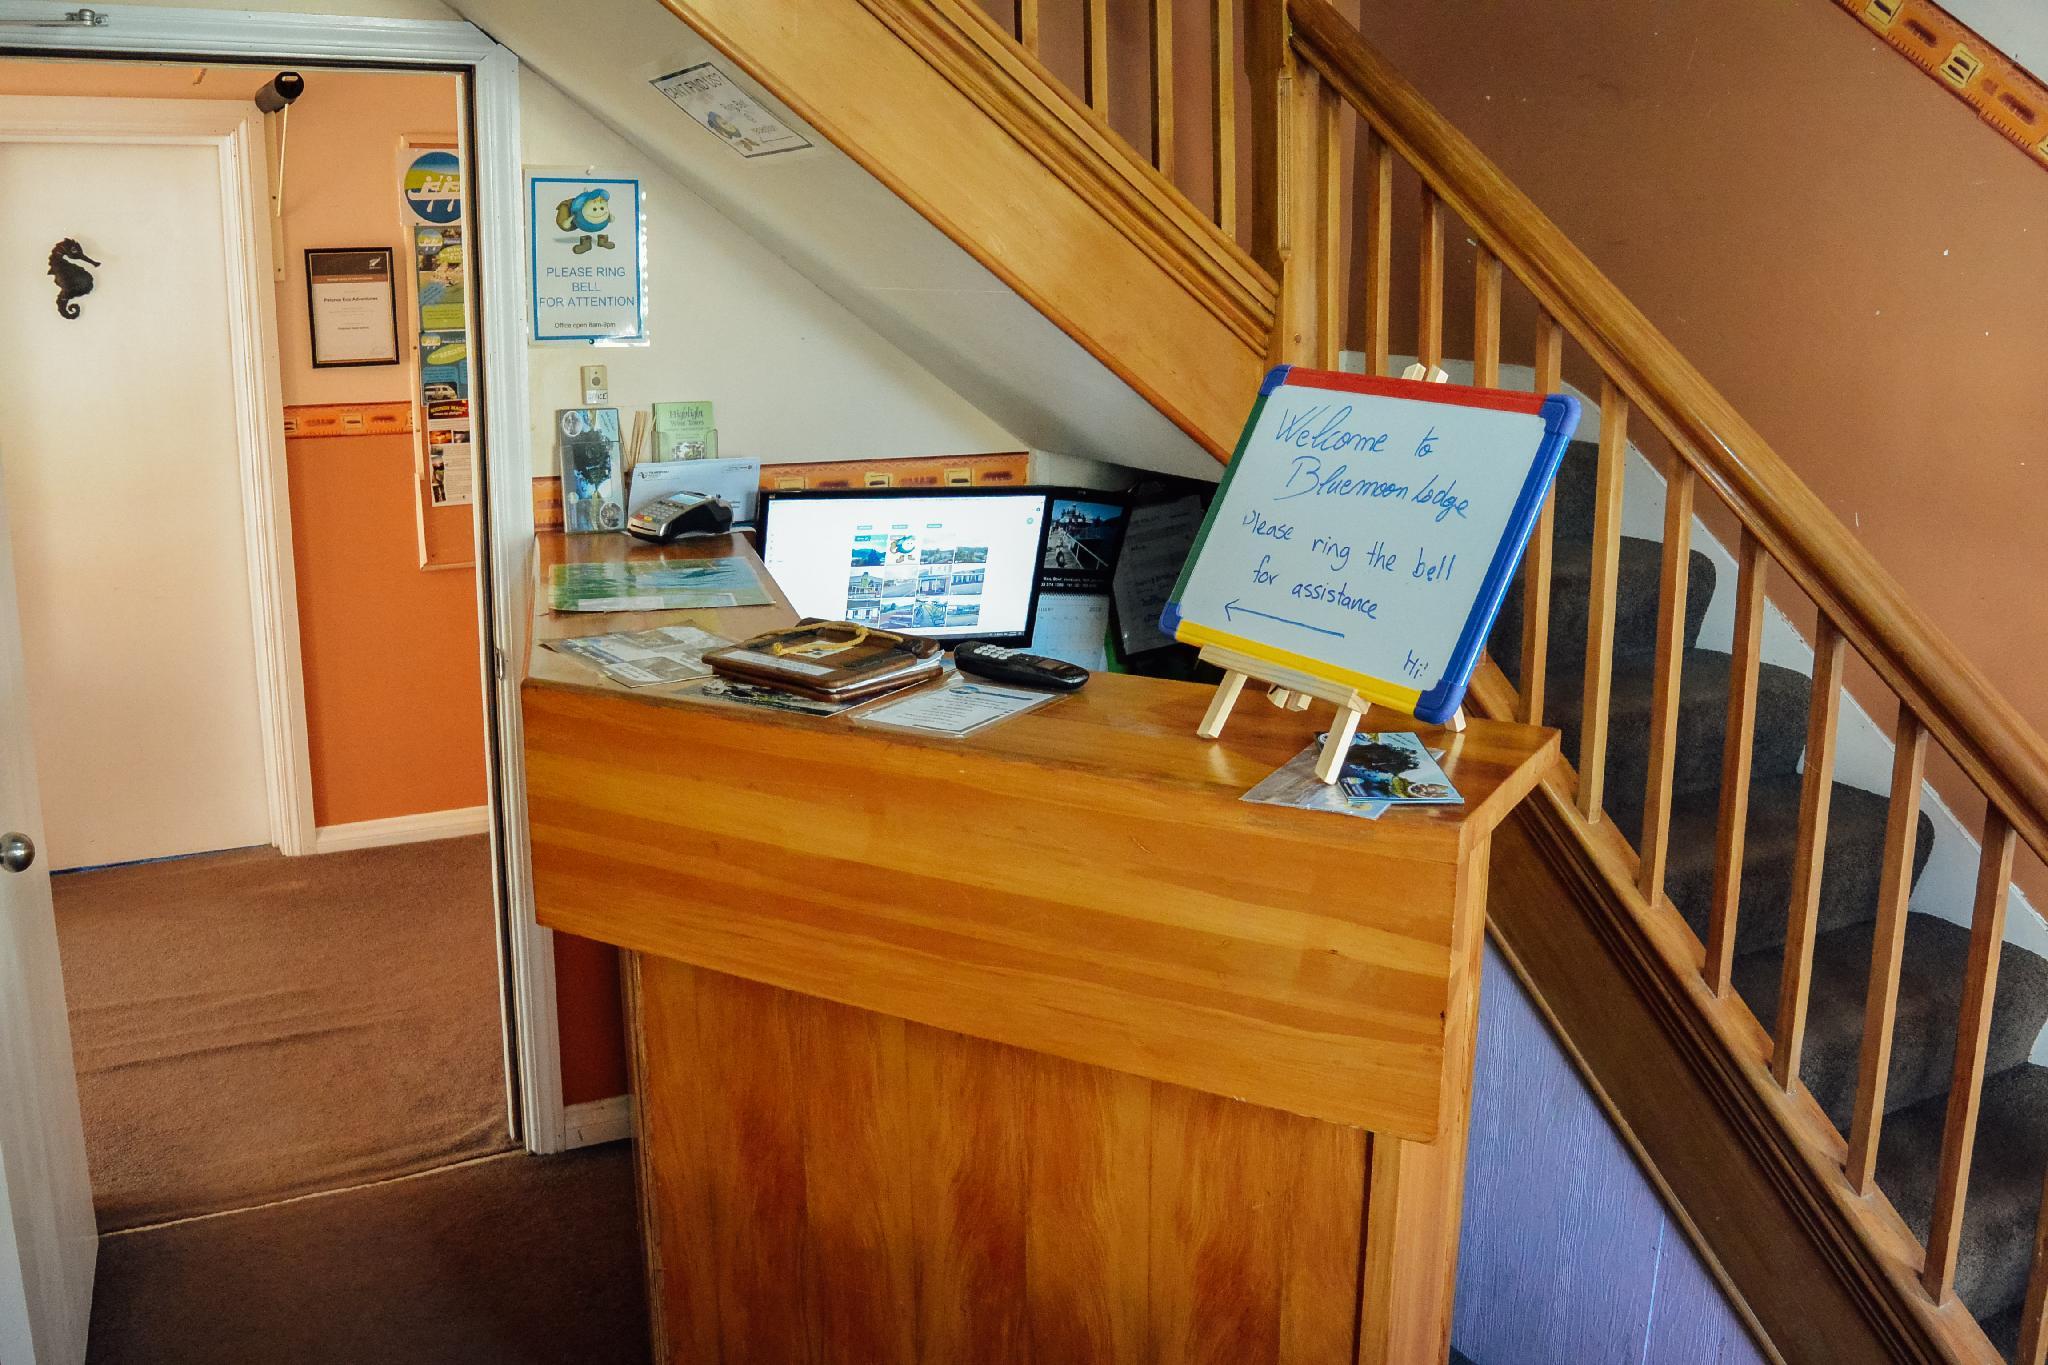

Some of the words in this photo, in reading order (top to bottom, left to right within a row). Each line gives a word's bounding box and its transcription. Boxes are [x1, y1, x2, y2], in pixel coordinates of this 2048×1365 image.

[546, 266, 593, 278] PLEASE
[596, 266, 626, 277] RING
[572, 282, 601, 292] BELL
[539, 297, 565, 308] FOR
[567, 296, 635, 307] ATTENTION
[1275, 405, 1388, 453] Welcome
[1414, 426, 1439, 458] to
[1311, 536, 1351, 572] ring
[1366, 540, 1398, 572] the
[1412, 547, 1457, 582] bell
[1252, 554, 1280, 585] for
[1291, 582, 1378, 620] assistance
